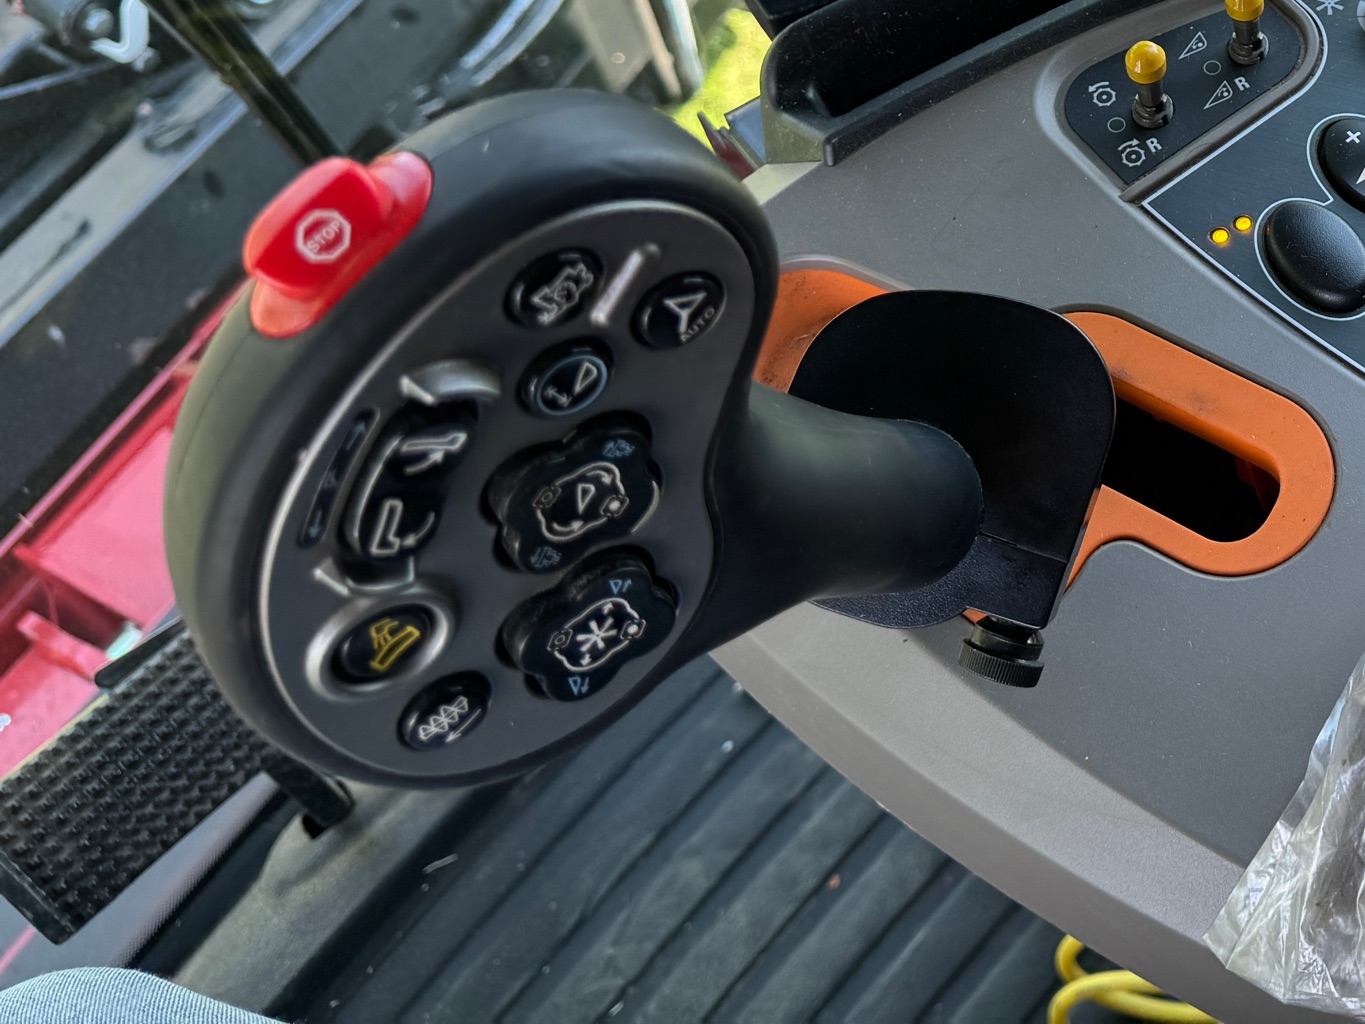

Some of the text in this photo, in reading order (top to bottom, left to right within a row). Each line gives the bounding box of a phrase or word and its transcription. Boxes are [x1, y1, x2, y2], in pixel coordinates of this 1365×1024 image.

[1233, 76, 1251, 92] R
[1146, 137, 1163, 152] R
[307, 220, 341, 254] STOP
[680, 307, 715, 343] AUTO
